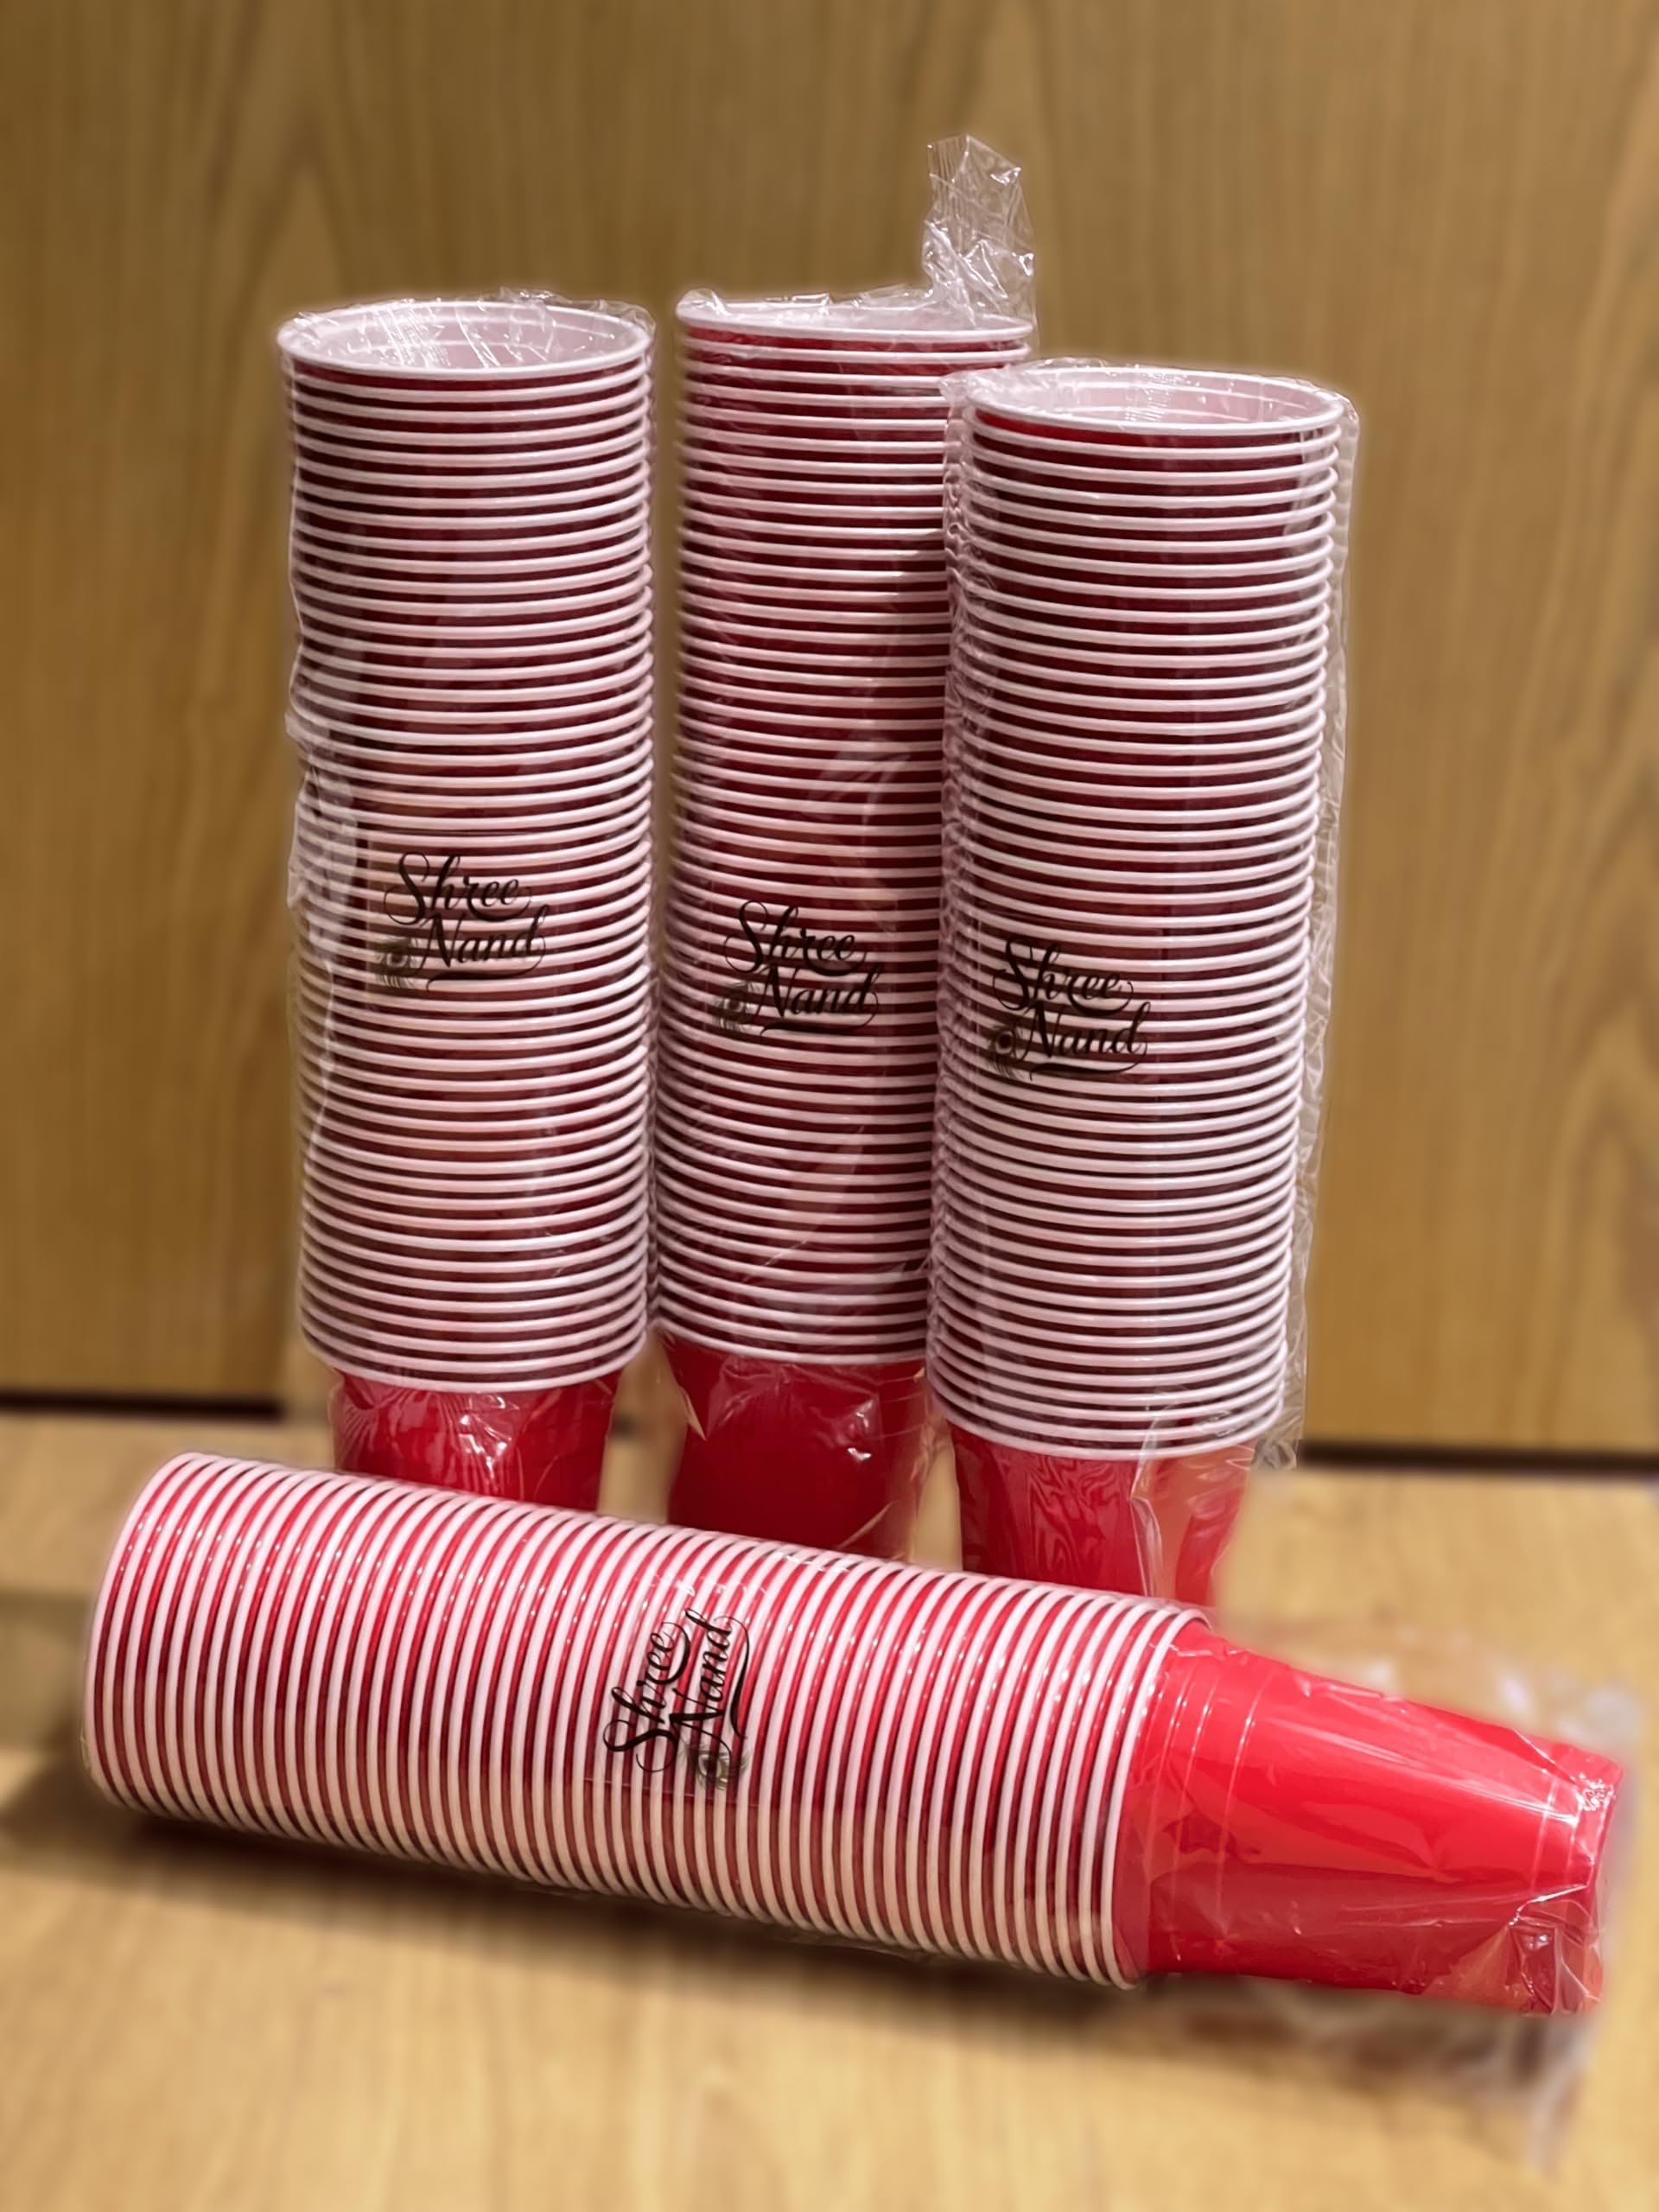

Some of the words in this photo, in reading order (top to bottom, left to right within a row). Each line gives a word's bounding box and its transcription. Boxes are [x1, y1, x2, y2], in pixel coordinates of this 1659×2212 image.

[385, 852, 531, 925] Shree
[413, 905, 550, 981] Nand
[724, 900, 866, 976] Shree
[753, 963, 882, 1034] Nand
[994, 937, 1134, 1016] Shree
[1022, 1001, 1150, 1074] Nand
[603, 1622, 690, 1772] Shree
[670, 1608, 749, 1741] Nand
